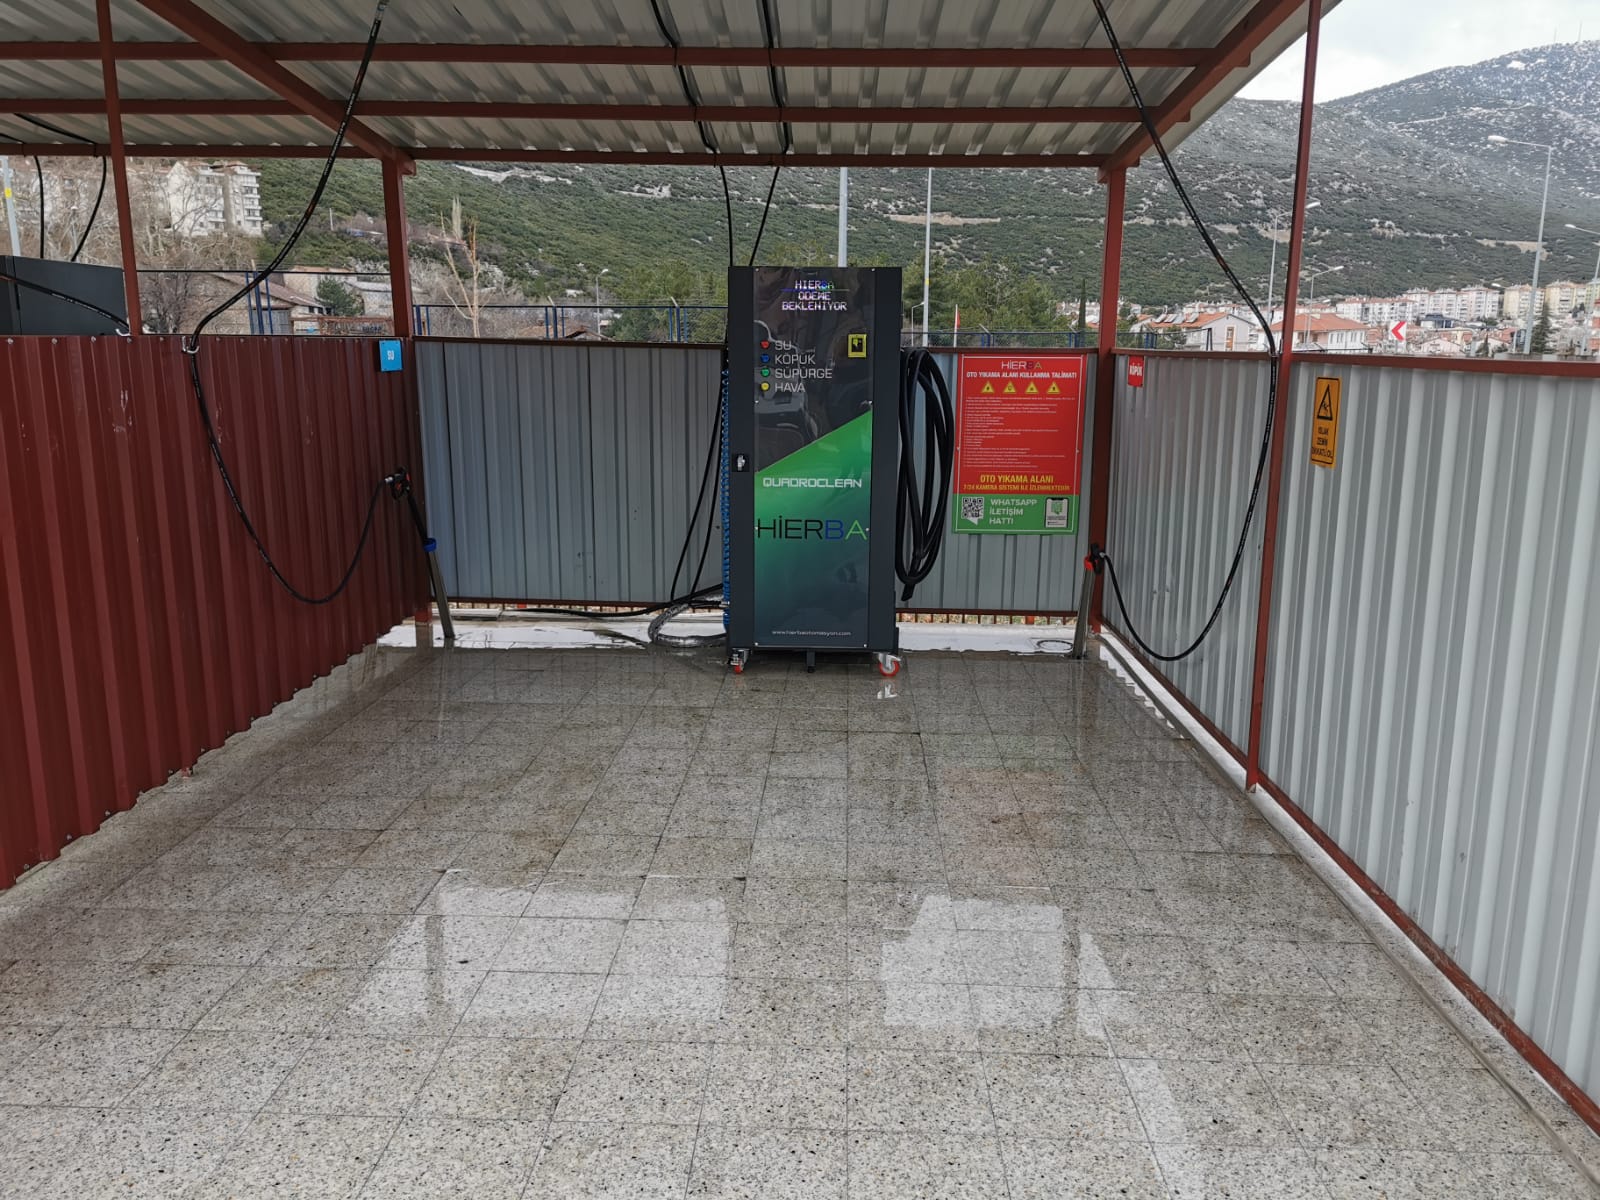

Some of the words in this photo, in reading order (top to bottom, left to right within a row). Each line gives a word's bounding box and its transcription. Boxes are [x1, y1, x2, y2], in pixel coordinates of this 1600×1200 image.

[774, 341, 792, 350] SU
[774, 383, 806, 393] HAVA
[763, 477, 862, 488] QUADROCLEAN
[980, 474, 996, 483] OTO
[997, 474, 1028, 483] YIKAMA
[1030, 475, 1054, 483] ALANI
[989, 517, 1013, 525] HATTI
[757, 515, 868, 540] HİERBA
